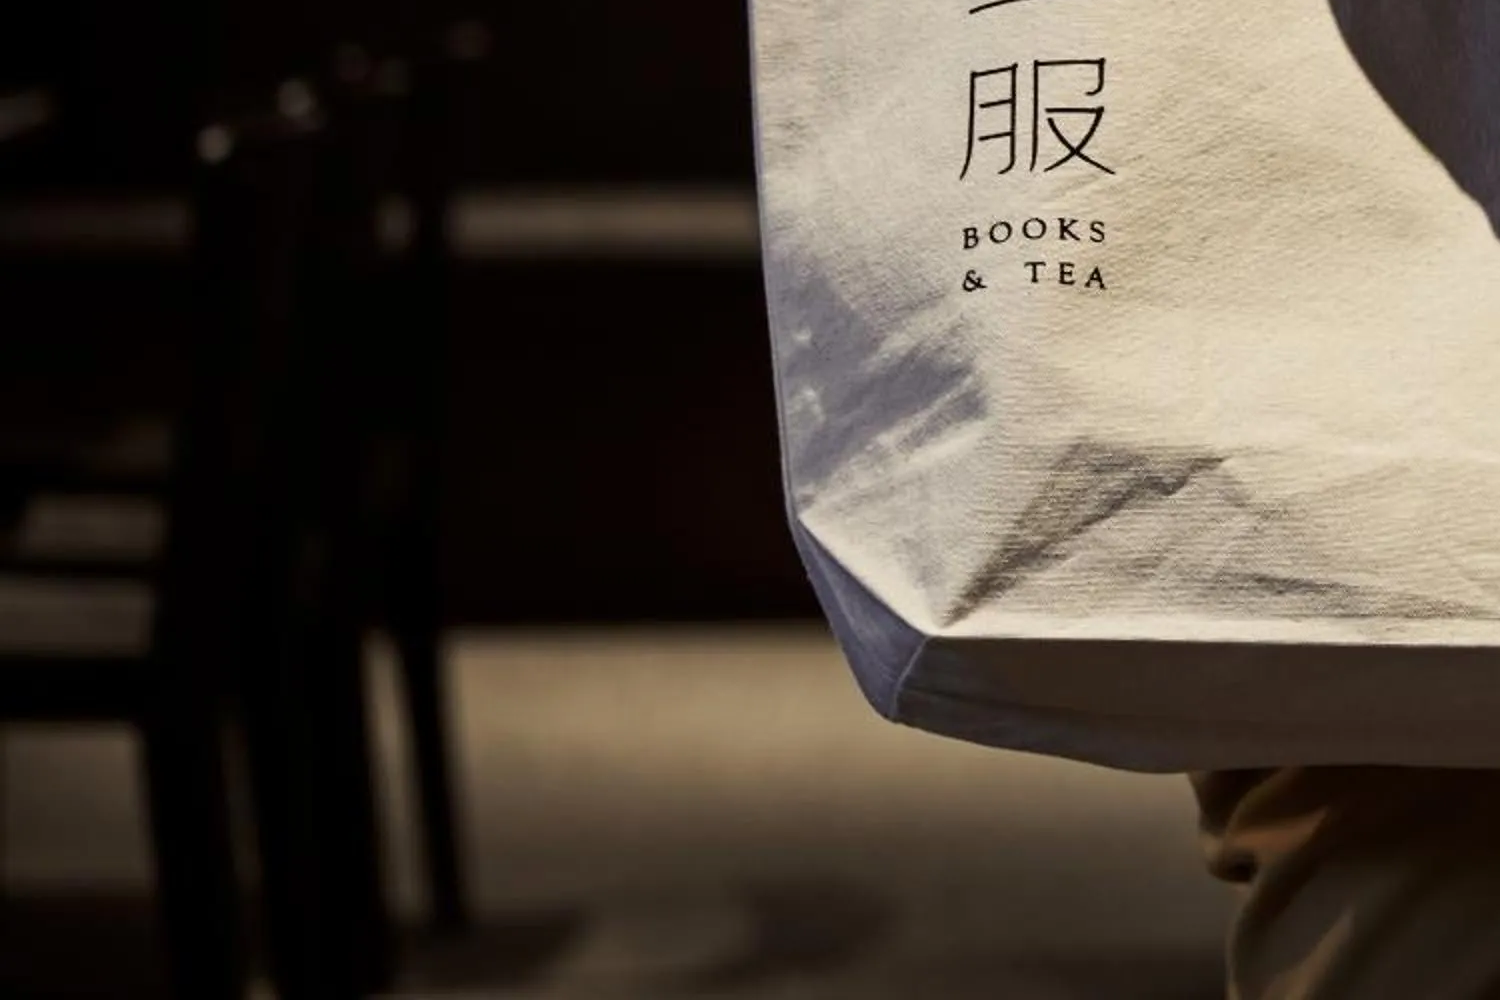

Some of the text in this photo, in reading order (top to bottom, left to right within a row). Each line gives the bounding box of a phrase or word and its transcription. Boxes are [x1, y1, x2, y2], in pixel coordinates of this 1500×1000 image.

[962, 217, 1106, 250] BOOKS
[961, 261, 1108, 293] & TEA
